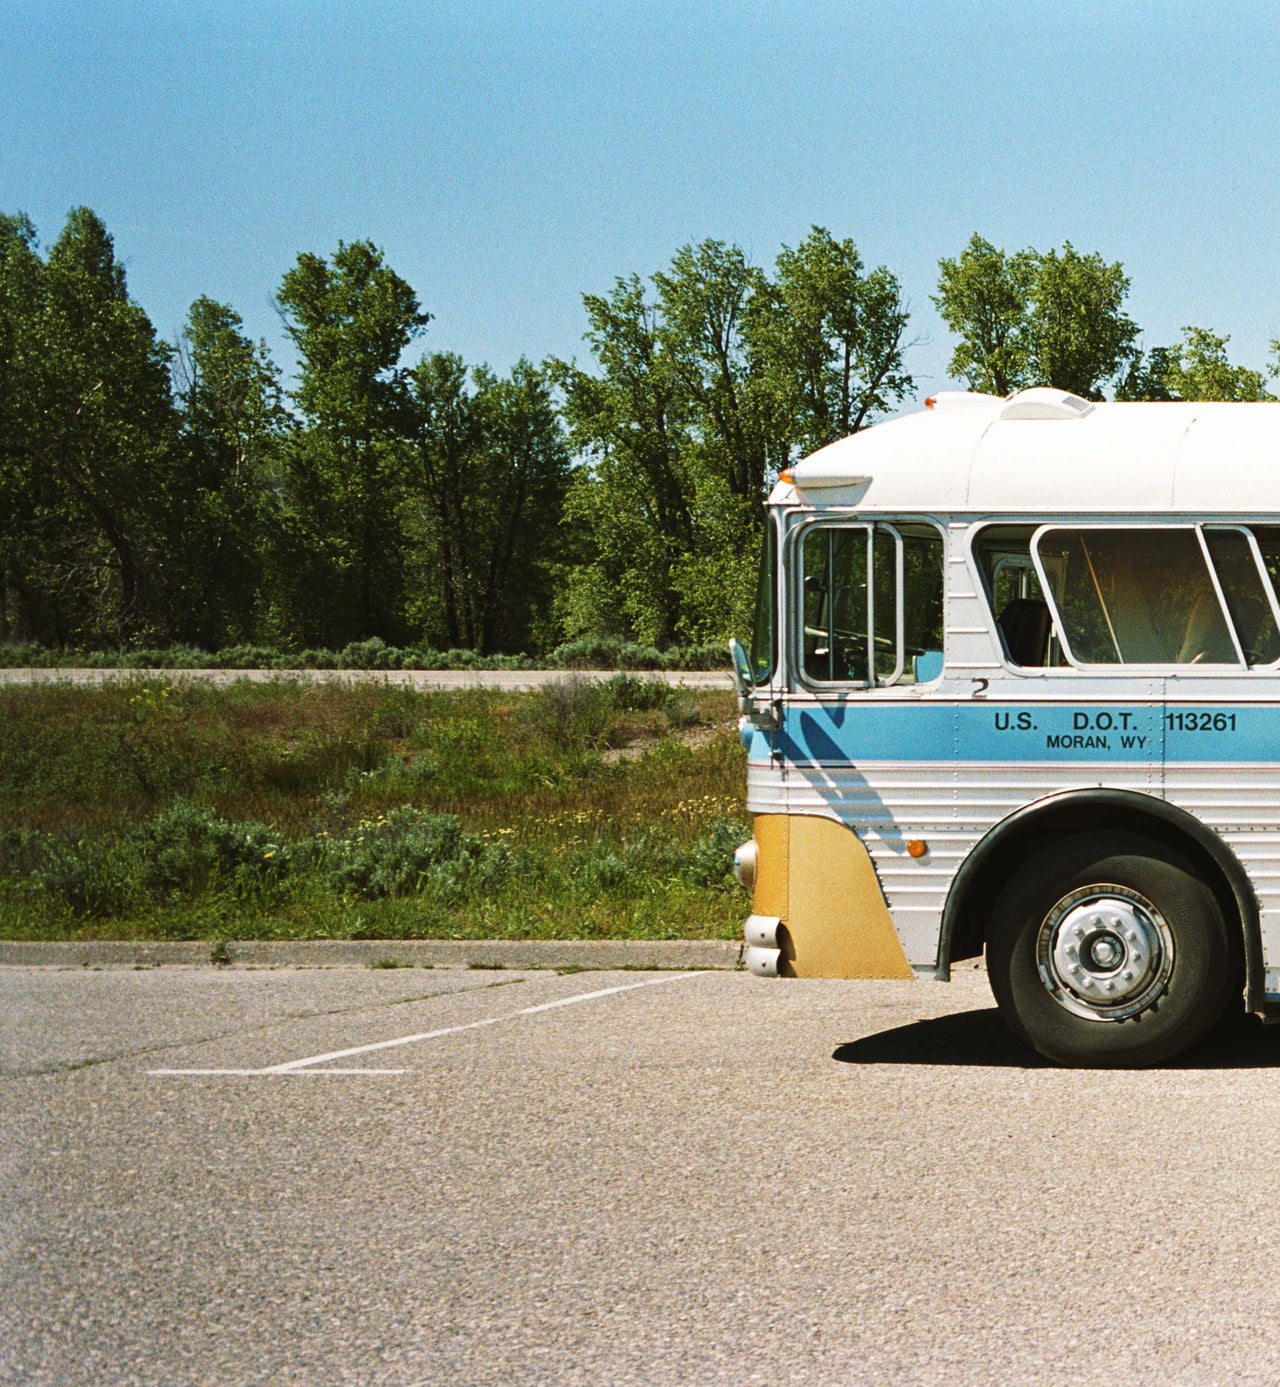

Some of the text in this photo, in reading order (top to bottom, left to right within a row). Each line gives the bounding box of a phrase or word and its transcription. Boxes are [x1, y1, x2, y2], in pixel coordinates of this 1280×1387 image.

[971, 678, 989, 698] 2
[995, 712, 1236, 731] U.S. D.O.T. 113261
[1046, 735, 1147, 750] MORAN, WY
